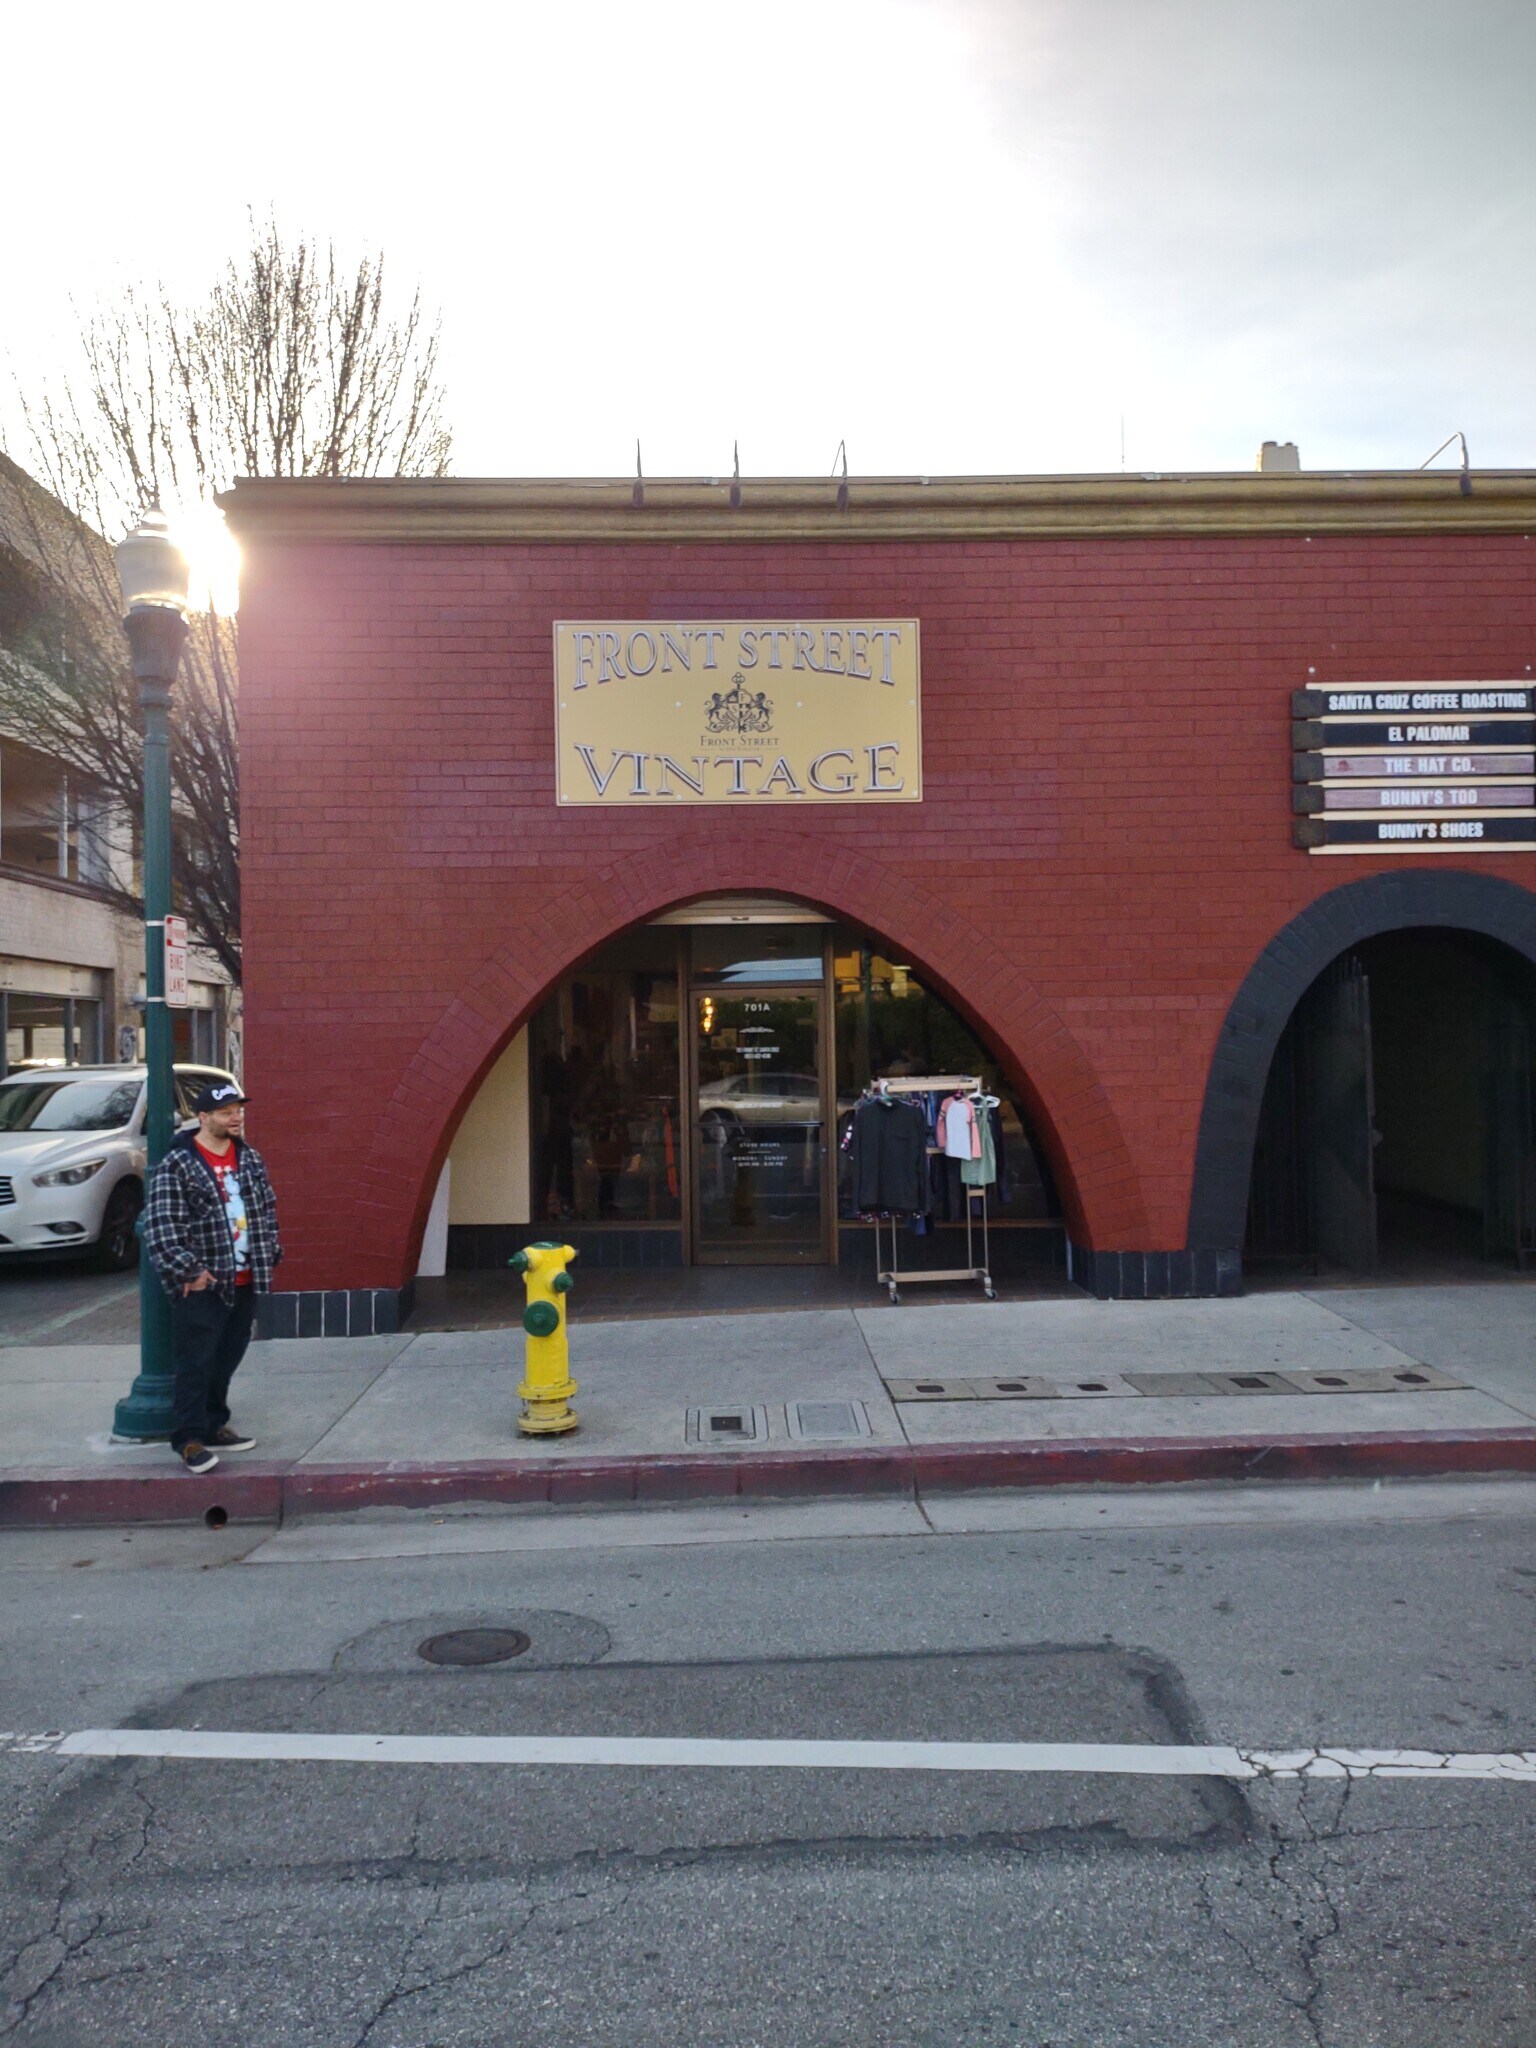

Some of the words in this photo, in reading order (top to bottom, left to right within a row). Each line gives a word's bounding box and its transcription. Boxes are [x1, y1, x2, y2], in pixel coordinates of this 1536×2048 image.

[573, 629, 725, 690] FRONT
[738, 628, 902, 686] STREET
[1328, 695, 1373, 711] SANTA
[1375, 694, 1410, 711] CRUZ
[1412, 693, 1459, 710] COFFEE
[1461, 692, 1527, 709] ROASTING
[700, 735, 736, 747] FRONT
[740, 735, 780, 746] STREET
[1388, 726, 1404, 742] EL
[1406, 725, 1470, 742] PALOMAR
[574, 741, 905, 797] VINTAGE
[1384, 757, 1413, 773] THE
[1418, 757, 1447, 773] HAT
[1451, 757, 1476, 772] CO.
[1380, 790, 1444, 806] BUNNY'S
[1449, 789, 1478, 805] TOO
[1378, 823, 1437, 839] BUNNY'S
[1440, 822, 1484, 838] SHOES
[169, 977, 185, 993] LANE
[744, 1003, 771, 1012] 701A
